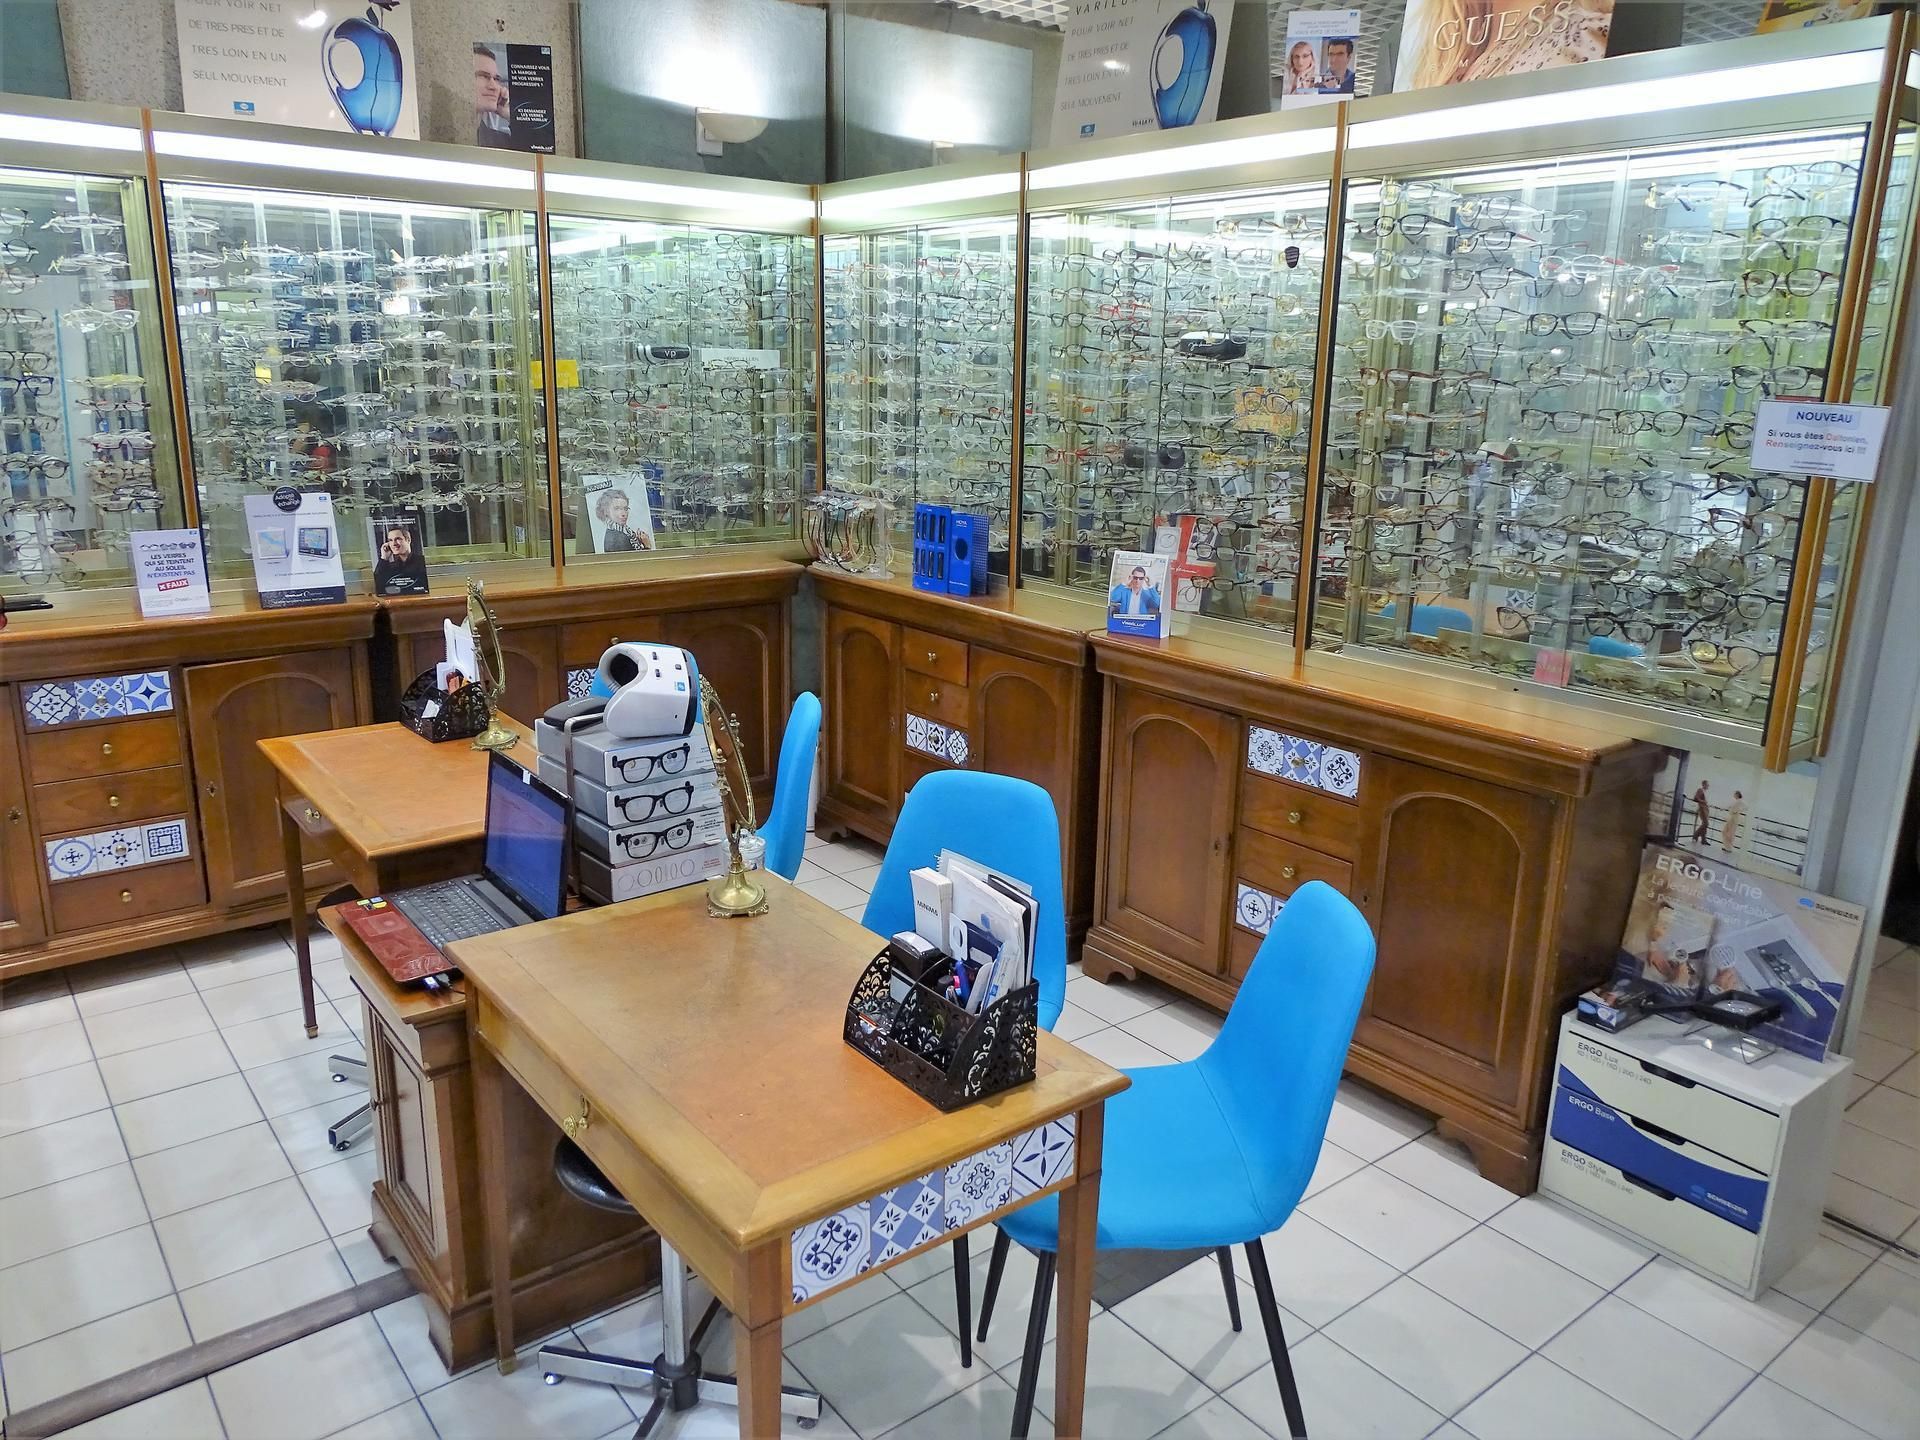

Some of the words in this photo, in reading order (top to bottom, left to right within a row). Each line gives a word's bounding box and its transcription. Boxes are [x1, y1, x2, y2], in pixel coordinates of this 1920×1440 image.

[259, 2, 281, 13] NET
[1076, 0, 1138, 15] VARILU
[188, 19, 201, 29] DE
[205, 21, 229, 33] TRES
[231, 24, 255, 35] PRES
[257, 27, 269, 36] ET
[271, 28, 285, 38] DE
[1432, 0, 1572, 51] GUESS
[192, 45, 219, 56] TRES
[222, 48, 248, 59] LOIN
[252, 51, 267, 60] EN
[270, 52, 287, 64] UN
[192, 70, 218, 80] SEUL
[220, 72, 288, 87] MOUVEMENT
[1796, 411, 1853, 424] NOUVEAU
[1767, 428, 1777, 437] Si
[1780, 431, 1801, 439] vous
[1804, 432, 1824, 441] êtes
[1845, 444, 1855, 454] ici
[166, 579, 188, 589] FAUX
[1577, 1042, 1603, 1057] ERGO
[1568, 1095, 1594, 1112] ERGO
[1595, 1107, 1616, 1122] Base
[1561, 1149, 1587, 1165] ERGO
[1588, 1160, 1608, 1176] Style
